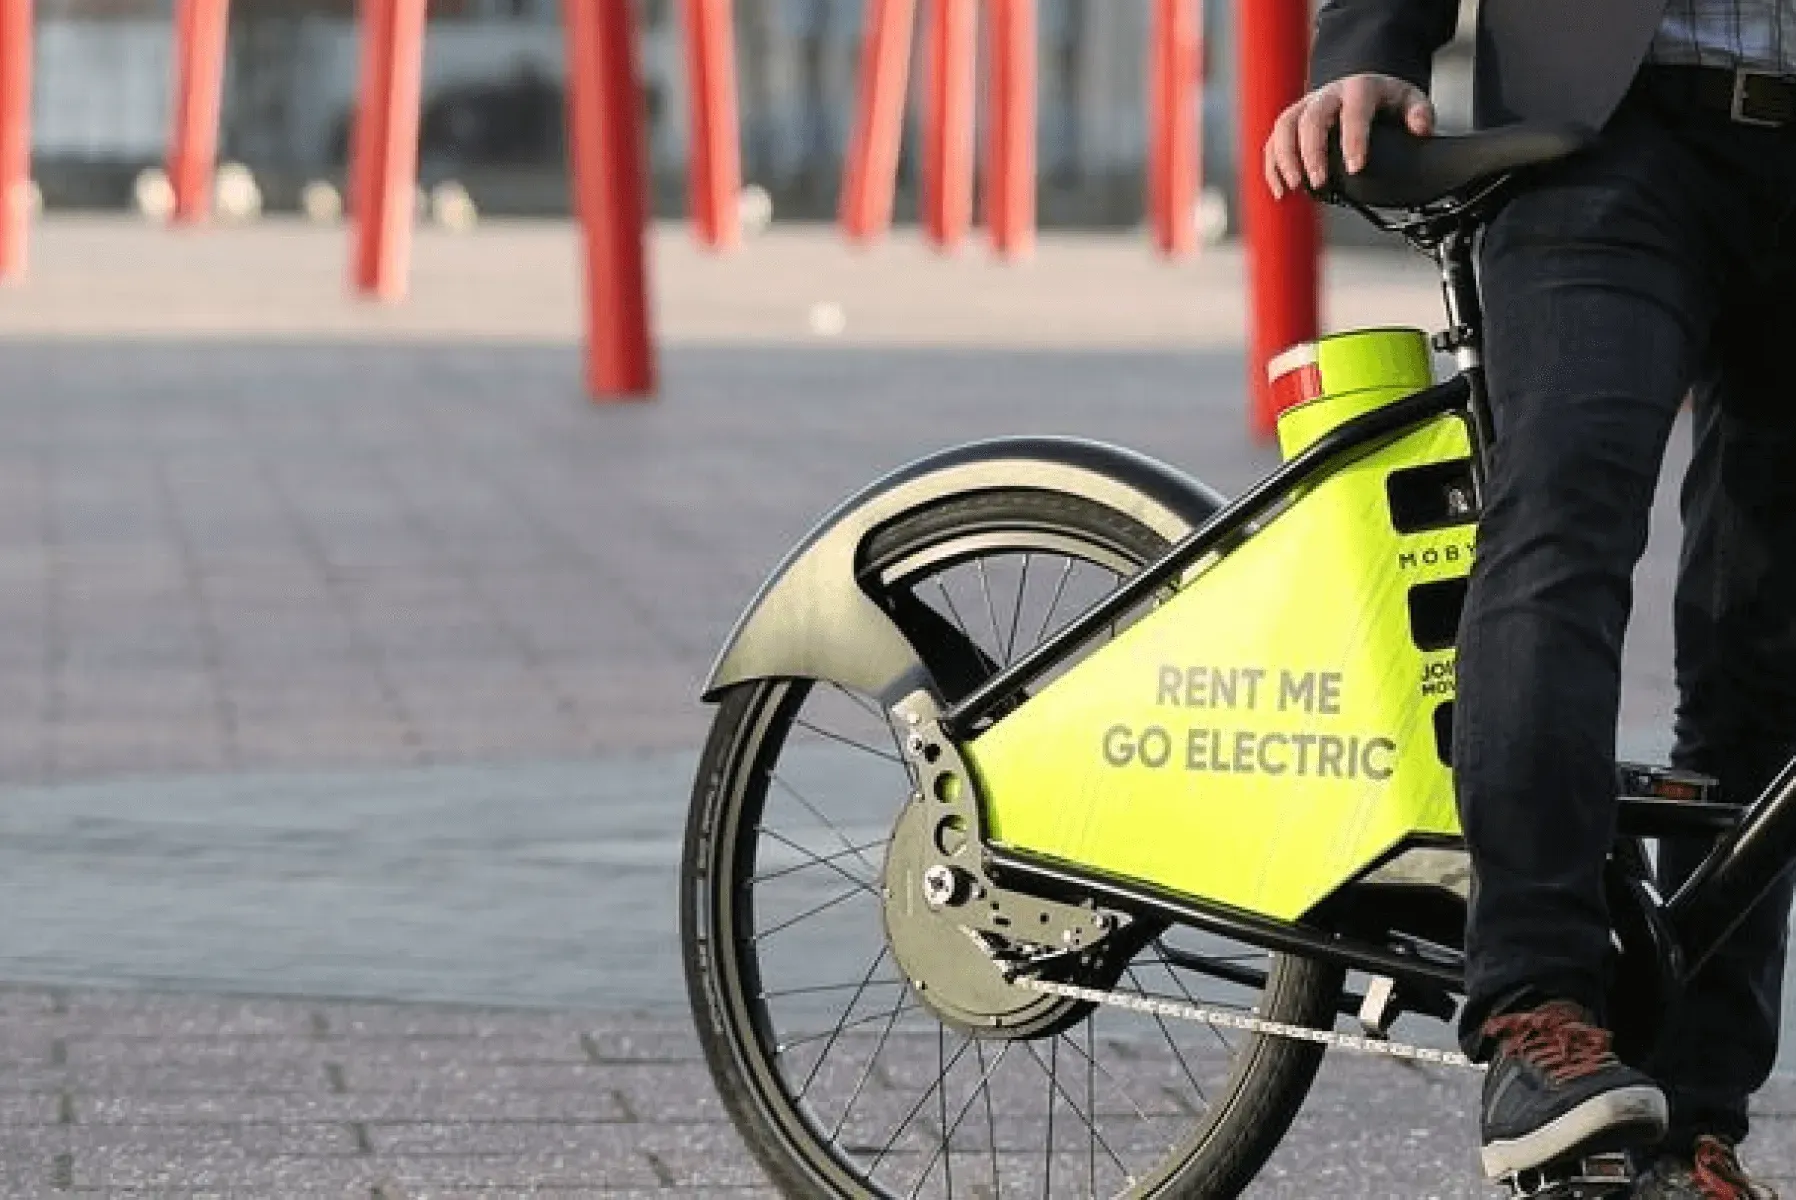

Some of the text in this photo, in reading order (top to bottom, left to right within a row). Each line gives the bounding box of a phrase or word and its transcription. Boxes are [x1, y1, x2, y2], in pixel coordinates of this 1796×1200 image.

[1156, 664, 1342, 715] RENT ME
[1102, 723, 1397, 781] GO ELECTRIC
